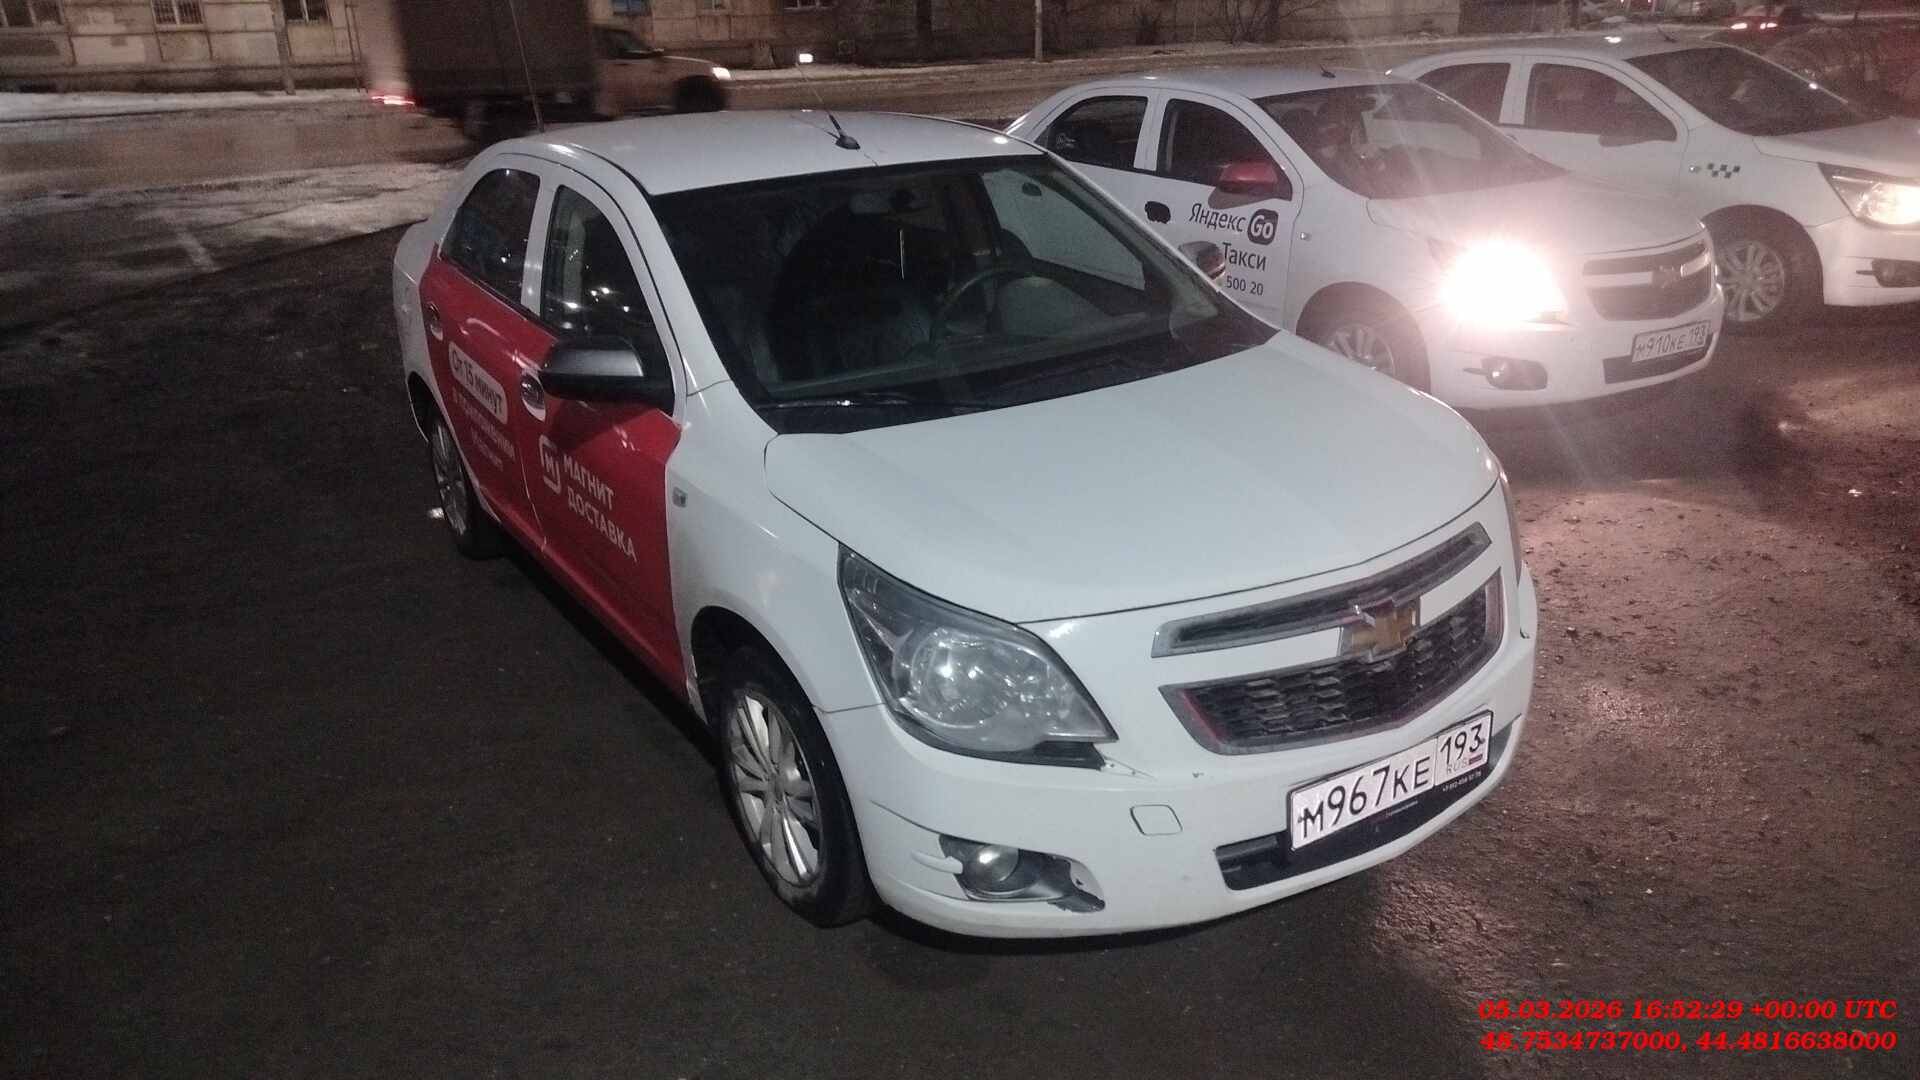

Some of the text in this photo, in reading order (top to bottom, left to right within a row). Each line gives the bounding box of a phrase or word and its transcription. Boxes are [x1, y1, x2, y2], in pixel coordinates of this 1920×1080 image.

[1189, 203, 1246, 232] Яндекс
[1250, 214, 1274, 239] Go
[1222, 242, 1267, 271] Такси
[1226, 275, 1264, 296] 500 20
[564, 454, 614, 510] МАГНИТ
[568, 485, 638, 563] ДОСТАВКА
[1301, 723, 1484, 838] М967КЕ 193
